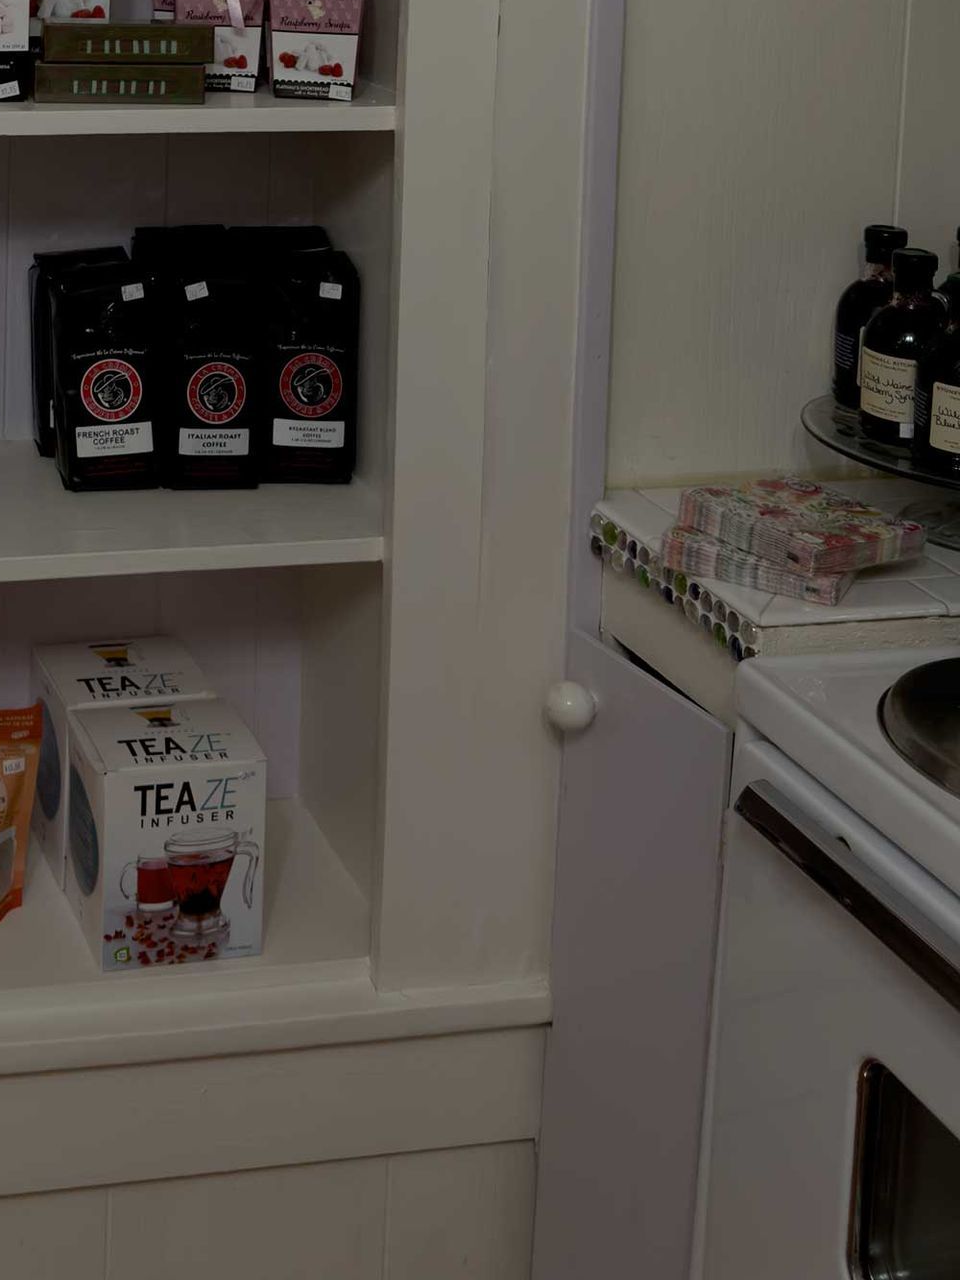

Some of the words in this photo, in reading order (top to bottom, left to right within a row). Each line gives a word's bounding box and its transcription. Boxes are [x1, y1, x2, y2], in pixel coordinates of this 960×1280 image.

[77, 430, 111, 439] FRENCH
[112, 428, 141, 436] ROAST
[93, 436, 125, 446] COFFEE
[77, 672, 178, 694] TEAZE
[91, 687, 181, 699] INFUSER
[117, 733, 227, 757] TEAZE
[134, 752, 229, 764] INFUSER
[134, 777, 240, 816] TEAZE
[141, 810, 234, 829] INFUSER
